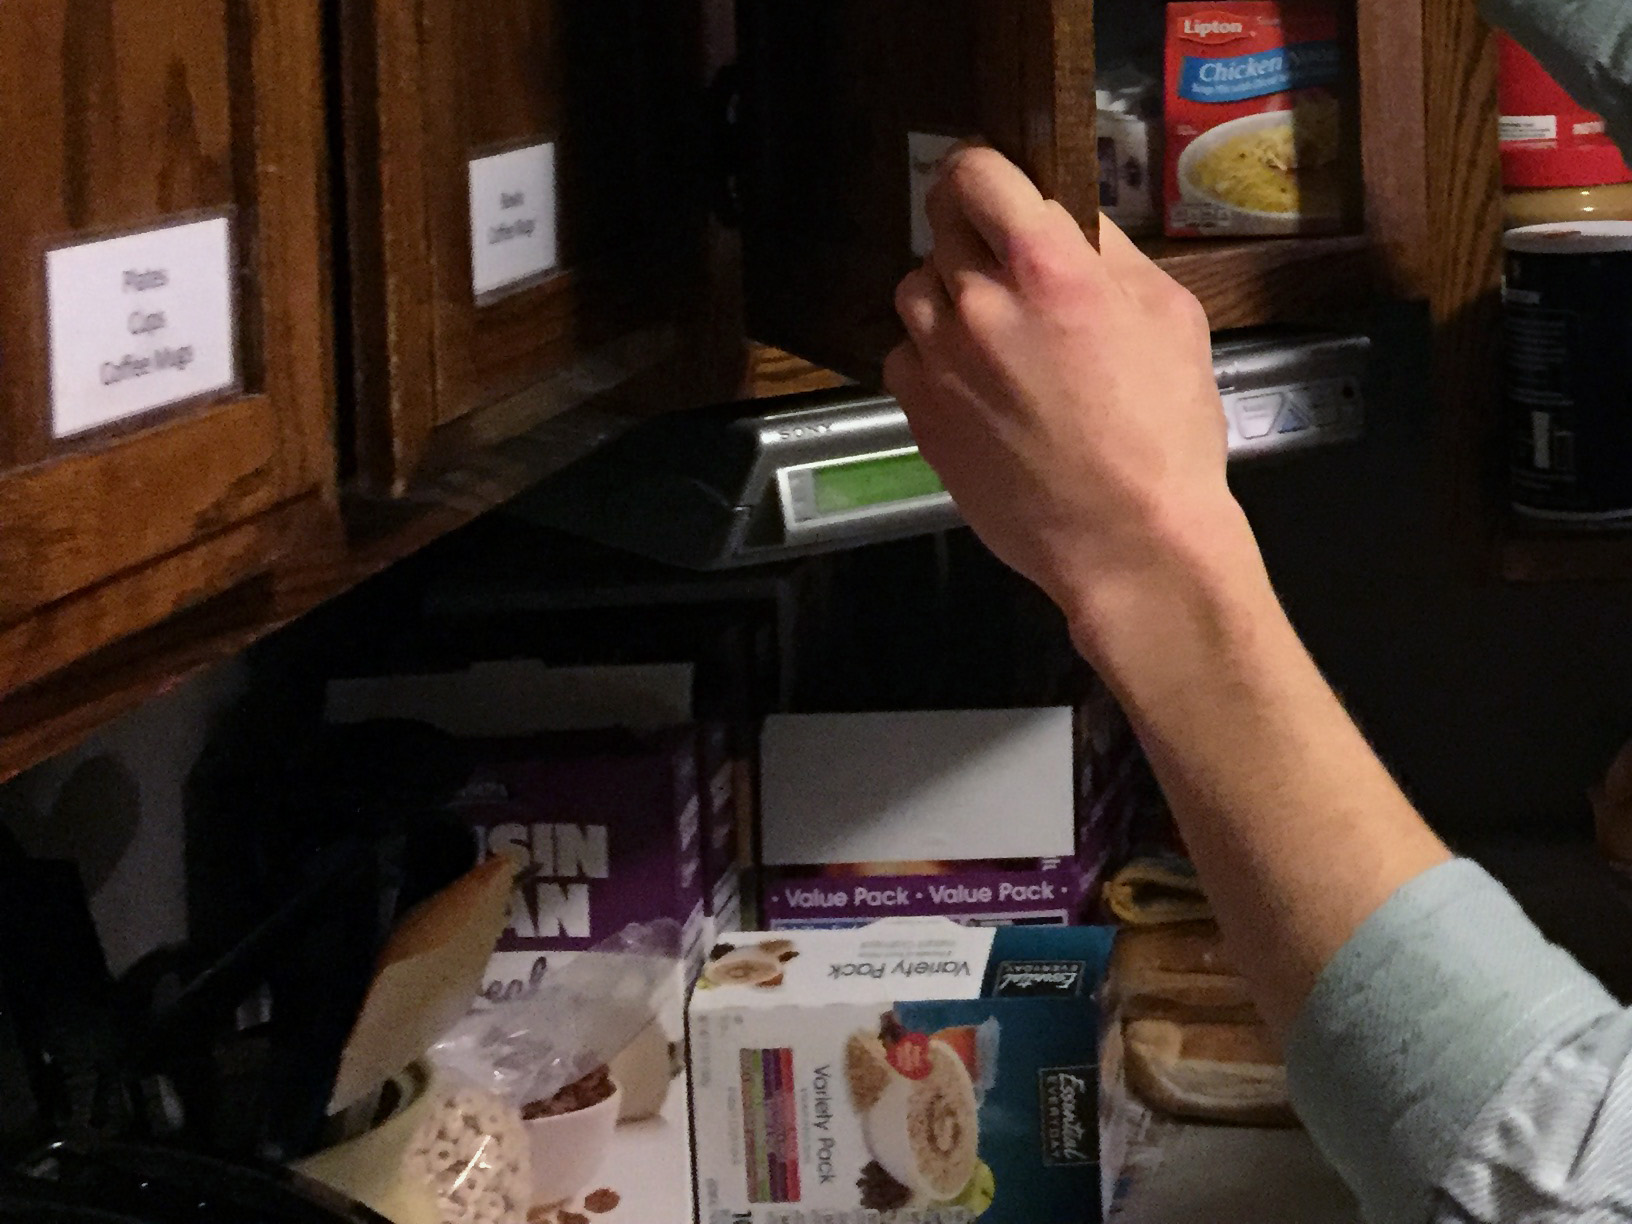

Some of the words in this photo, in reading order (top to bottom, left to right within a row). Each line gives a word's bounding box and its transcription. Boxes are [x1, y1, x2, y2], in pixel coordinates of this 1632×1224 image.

[1183, 19, 1243, 37] Lipton
[1199, 55, 1283, 82] Chicken
[784, 887, 847, 909] Value
[853, 885, 911, 907] Pack
[927, 884, 993, 904] Value
[997, 880, 1055, 902] Pack
[827, 962, 886, 979] Pack
[891, 960, 971, 979] Variety
[998, 972, 1078, 990] Essential
[811, 1064, 834, 1132] Variety
[1058, 1072, 1087, 1160] Essential
[816, 1137, 836, 1184] Pack
